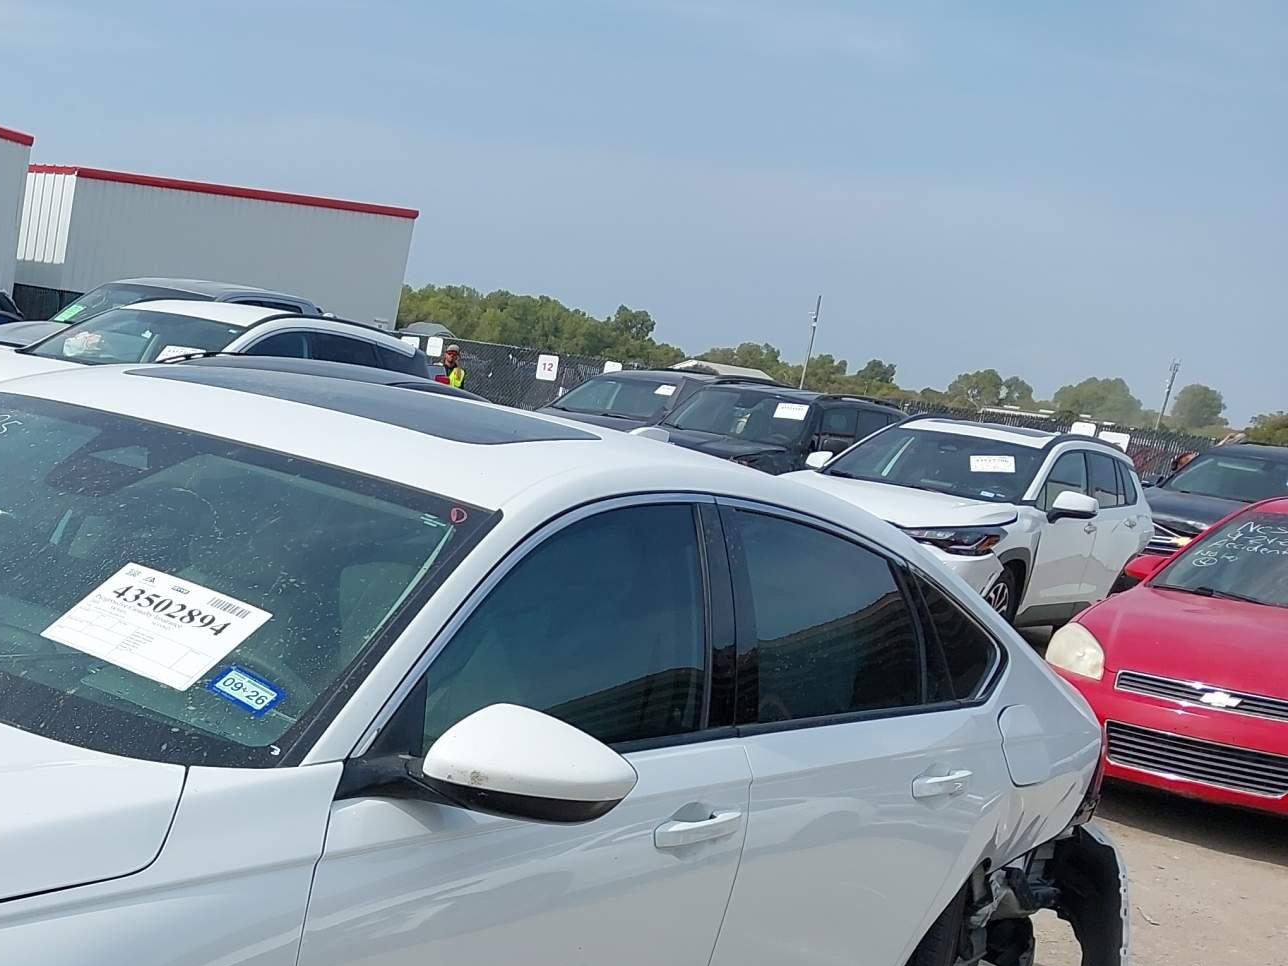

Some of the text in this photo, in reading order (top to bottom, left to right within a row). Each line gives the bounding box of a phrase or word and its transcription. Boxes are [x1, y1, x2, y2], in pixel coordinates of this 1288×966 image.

[542, 362, 554, 372] 12
[112, 584, 232, 637] 43502894
[222, 677, 244, 692] 09
[245, 690, 269, 706] 26
